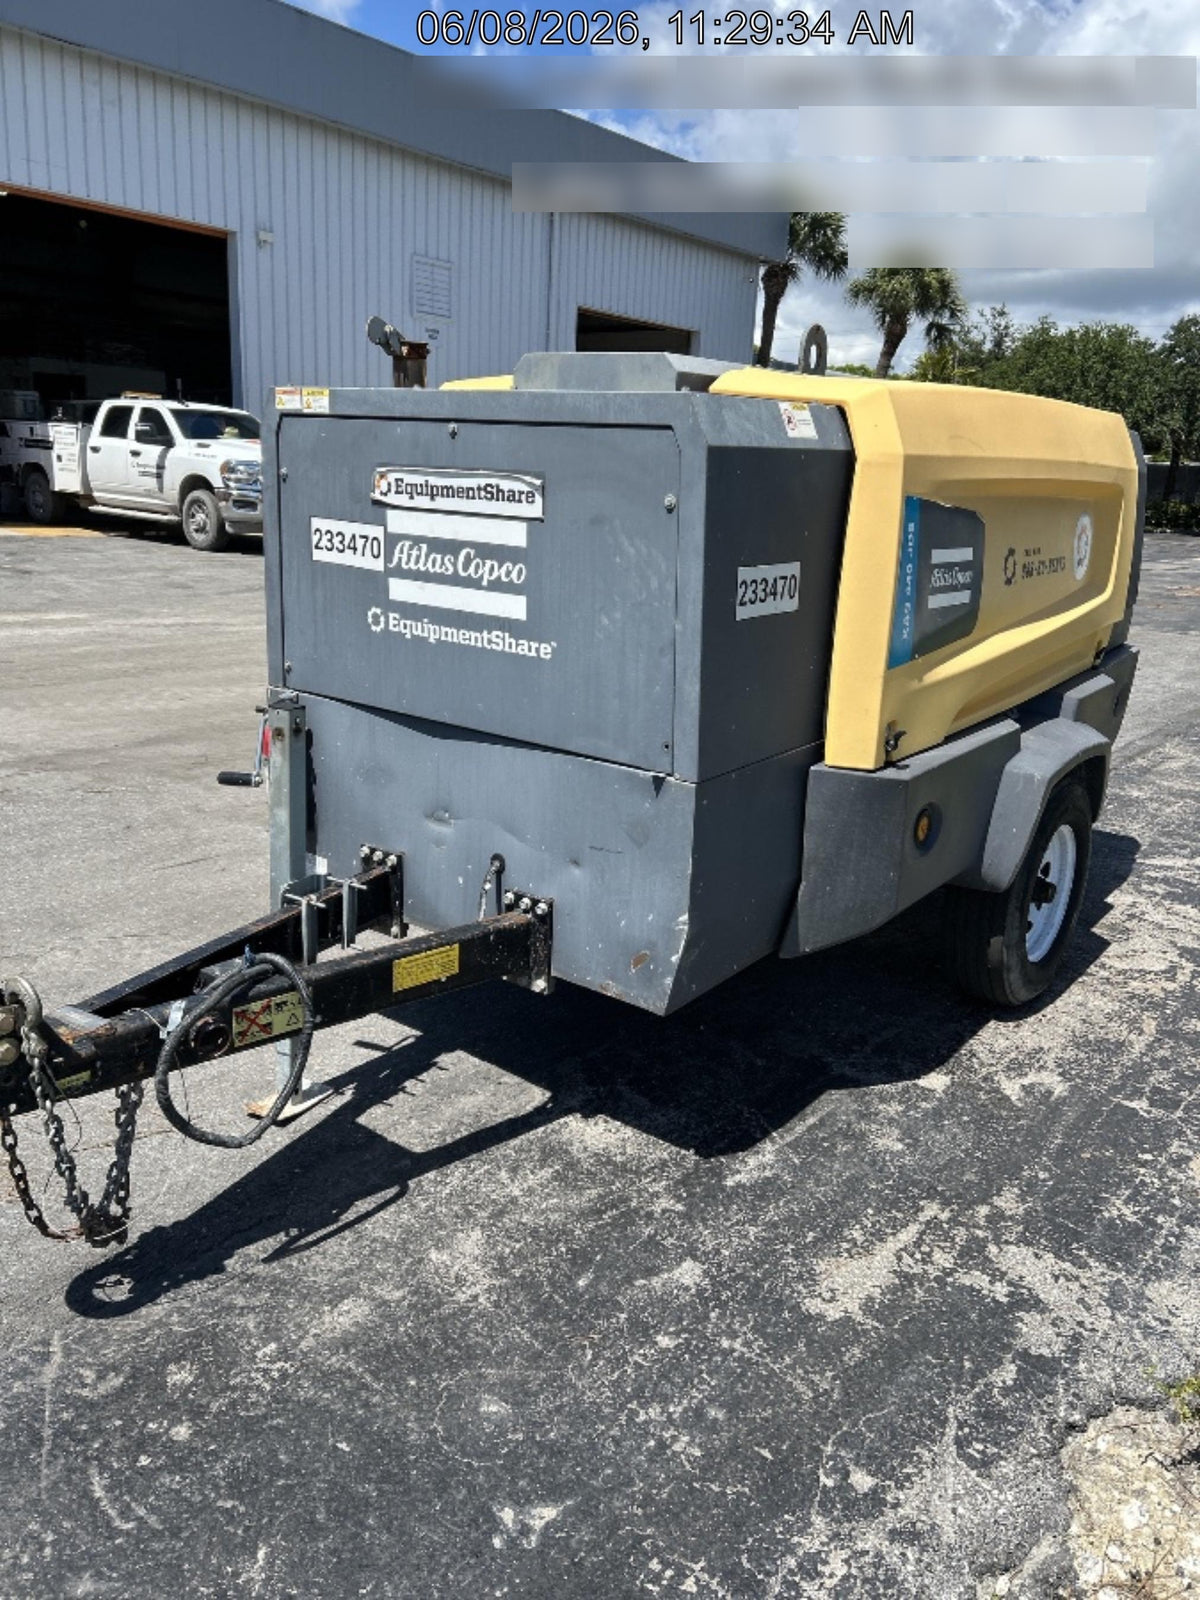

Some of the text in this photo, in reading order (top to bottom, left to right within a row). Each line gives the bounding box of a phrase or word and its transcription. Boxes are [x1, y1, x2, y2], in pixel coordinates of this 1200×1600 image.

[313, 527, 382, 560] 233470
[387, 540, 527, 587] Atlas Copco
[737, 573, 798, 608] 233470
